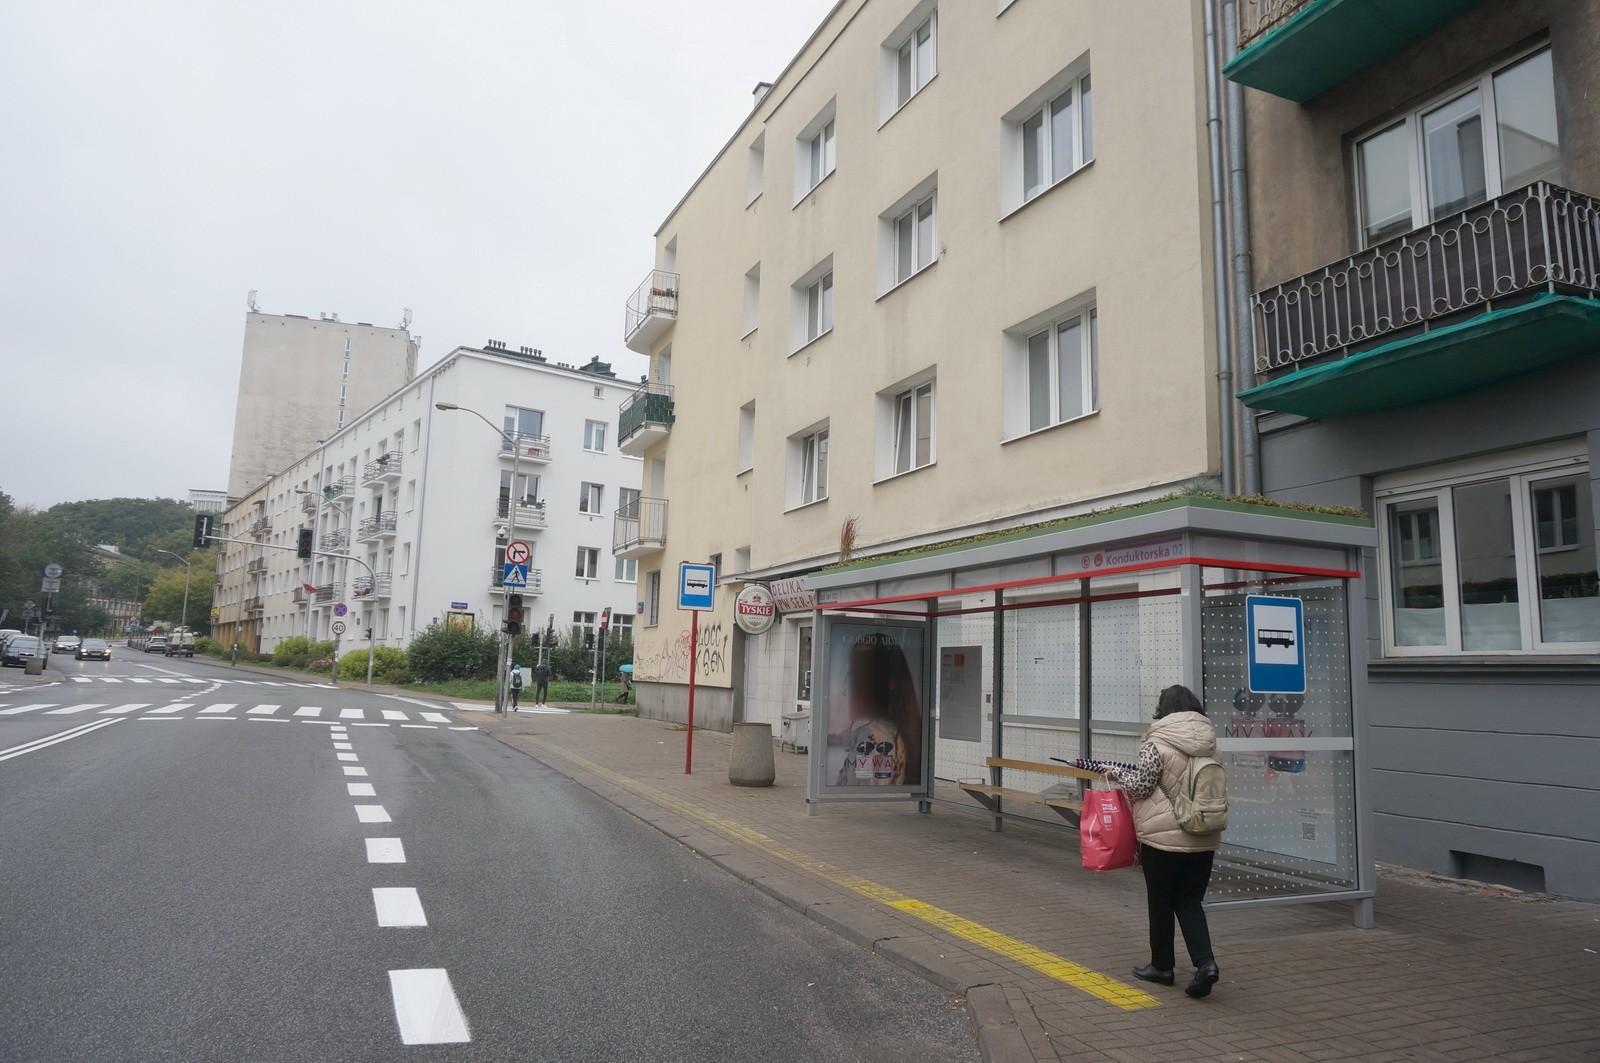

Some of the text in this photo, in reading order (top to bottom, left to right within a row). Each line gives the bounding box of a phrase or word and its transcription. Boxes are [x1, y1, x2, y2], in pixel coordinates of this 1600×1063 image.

[1105, 546, 1170, 566] Konduktorska
[741, 604, 771, 615] TYSKIE
[333, 624, 344, 632] 40
[847, 758, 866, 769] MY
